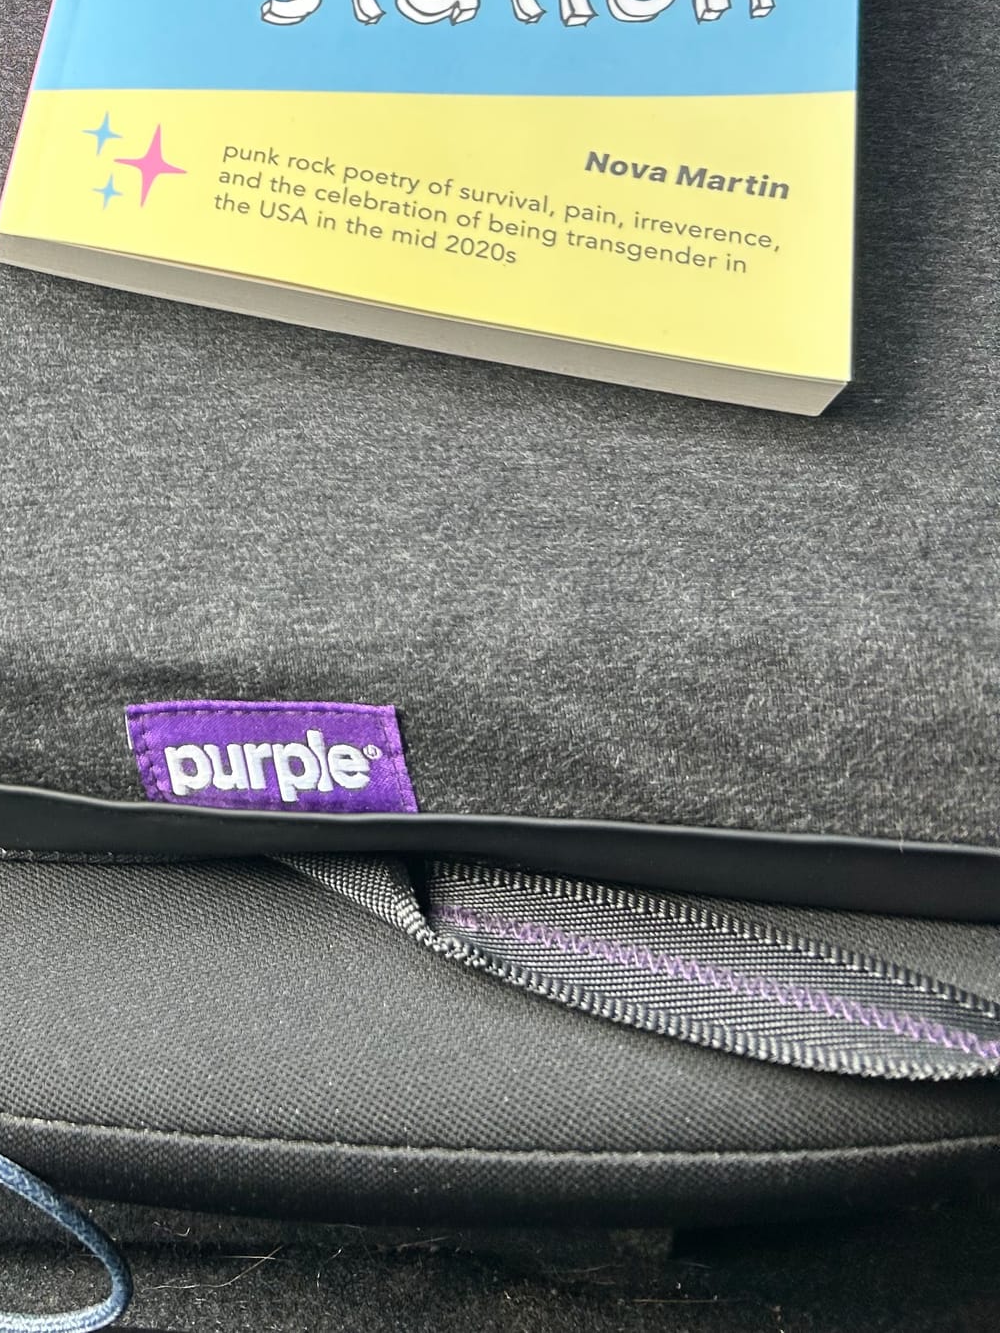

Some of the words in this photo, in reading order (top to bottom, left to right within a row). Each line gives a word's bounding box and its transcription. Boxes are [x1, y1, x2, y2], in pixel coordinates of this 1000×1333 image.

[222, 145, 280, 166] punk
[287, 156, 336, 177] rock
[342, 166, 421, 195] poetry
[427, 178, 454, 197] of
[458, 187, 555, 218] survival,
[564, 204, 624, 229] pain,
[634, 211, 780, 253] irreverence,
[584, 150, 668, 183] Nova
[675, 164, 790, 200] Martin
[214, 192, 251, 215] the
[259, 199, 308, 226] USA
[316, 210, 337, 231] in
[345, 215, 384, 239] the
[391, 228, 438, 250] mid
[444, 234, 517, 264] 2020s
[218, 171, 263, 190] and
[269, 175, 307, 198] the
[314, 186, 447, 224] celebration
[456, 210, 483, 229] of
[488, 212, 558, 248] being
[565, 229, 718, 269] transgender
[726, 252, 747, 274] in
